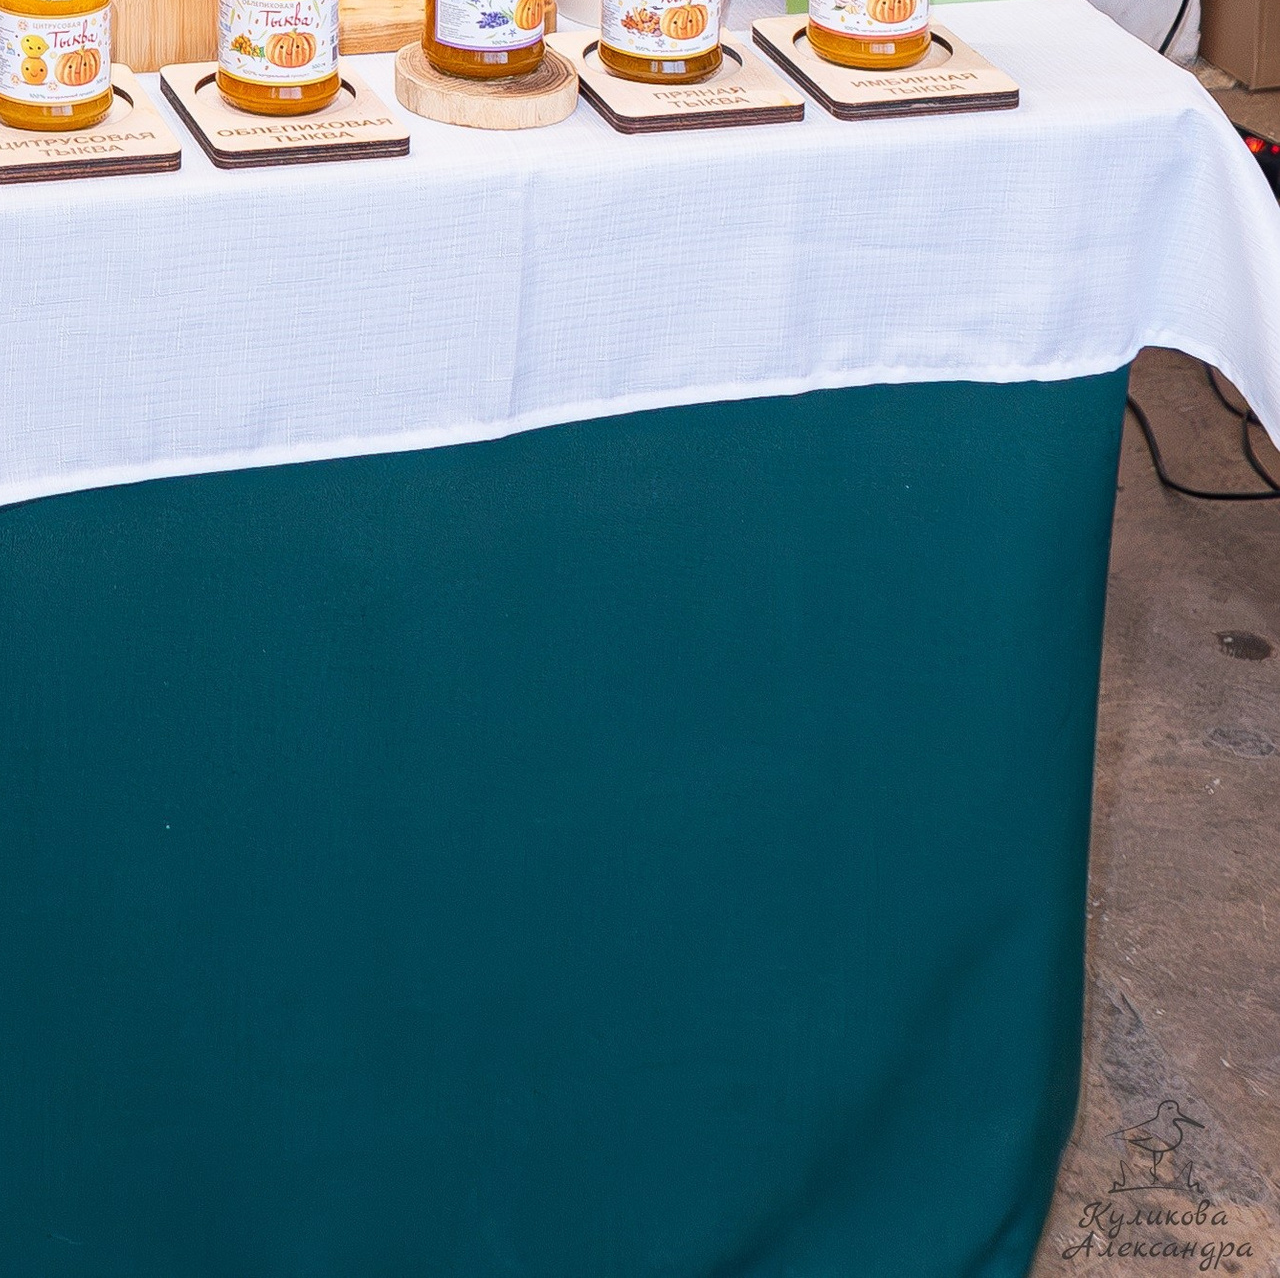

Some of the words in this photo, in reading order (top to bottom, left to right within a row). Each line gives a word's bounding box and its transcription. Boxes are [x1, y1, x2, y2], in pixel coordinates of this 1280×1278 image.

[241, 0, 294, 9] ОБЛЕПИХОВАЯ
[259, 2, 313, 27] Тыква
[32, 21, 81, 30] ЦИТРУСОВАЯ
[47, 19, 98, 49] Тыква
[851, 72, 978, 88] ИМБИРНАЯ
[653, 85, 747, 100] ПРЯНАЯ
[882, 84, 967, 95] ТЫКВА
[668, 96, 751, 108] ТЫКВА
[217, 116, 393, 139] ОБЛЕПИХОВАЯ
[270, 130, 355, 144] ТЫКВА
[40, 144, 124, 158] ТЫКВА
